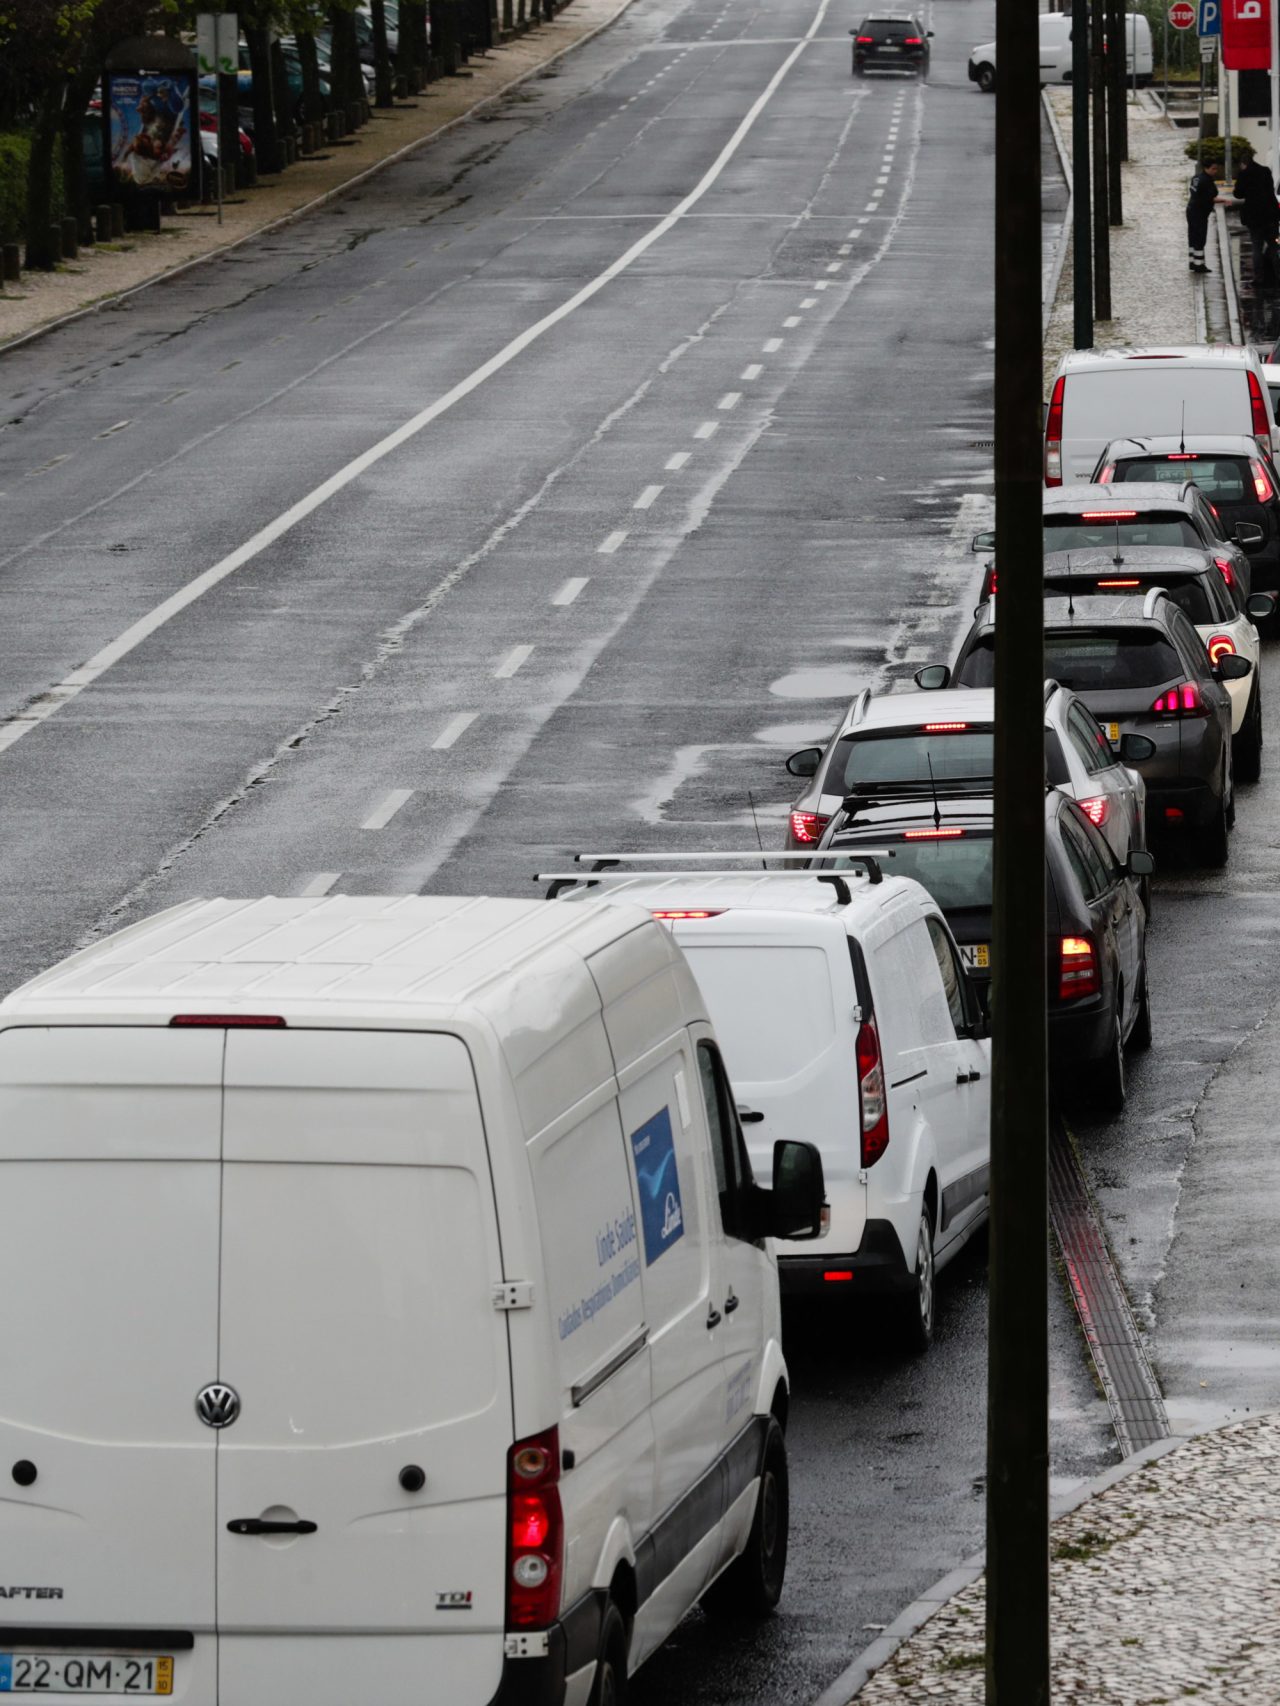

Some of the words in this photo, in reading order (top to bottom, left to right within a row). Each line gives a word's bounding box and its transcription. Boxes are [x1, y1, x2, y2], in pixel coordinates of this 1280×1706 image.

[1170, 11, 1194, 20] STOP
[1202, 2, 1217, 32] P
[435, 1591, 473, 1603] TDI
[158, 1661, 169, 1670] 15
[158, 1681, 168, 1690] 10
